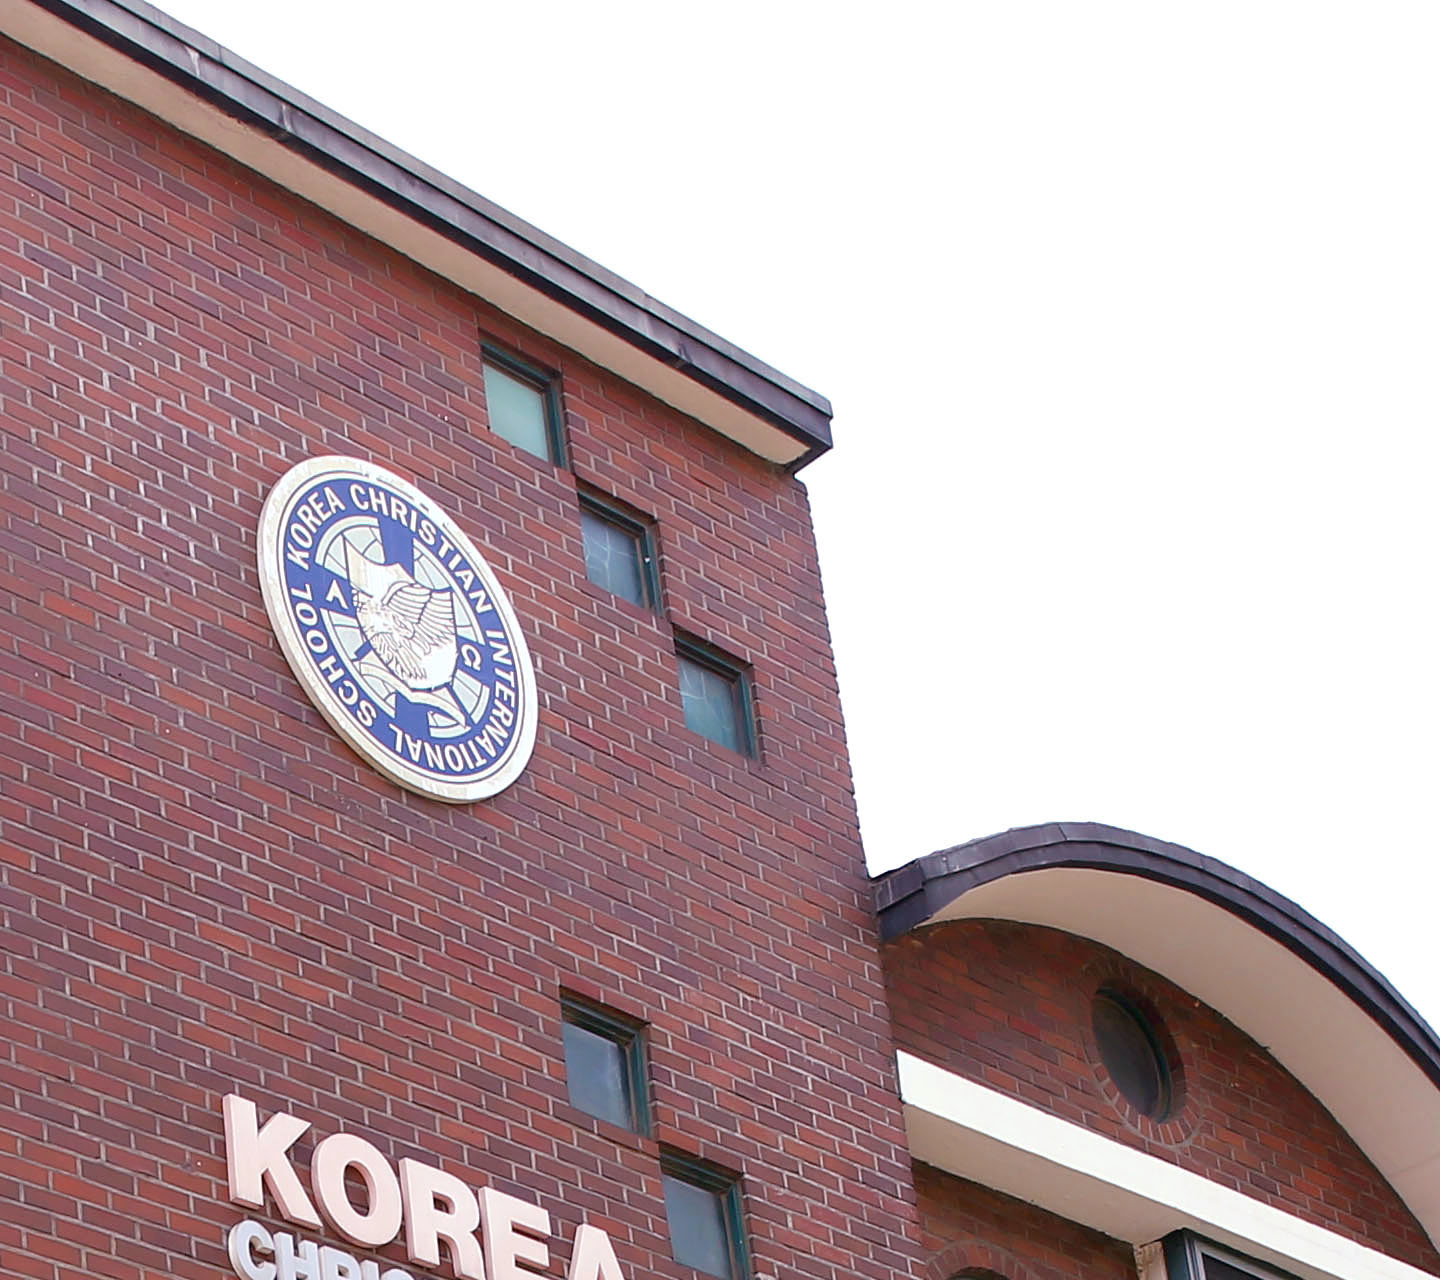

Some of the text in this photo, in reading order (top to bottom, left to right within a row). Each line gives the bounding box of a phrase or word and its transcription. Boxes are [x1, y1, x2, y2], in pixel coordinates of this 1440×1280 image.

[287, 483, 514, 773] KOREA CHRISTIAN INTERNATIONAL SCHOOL
